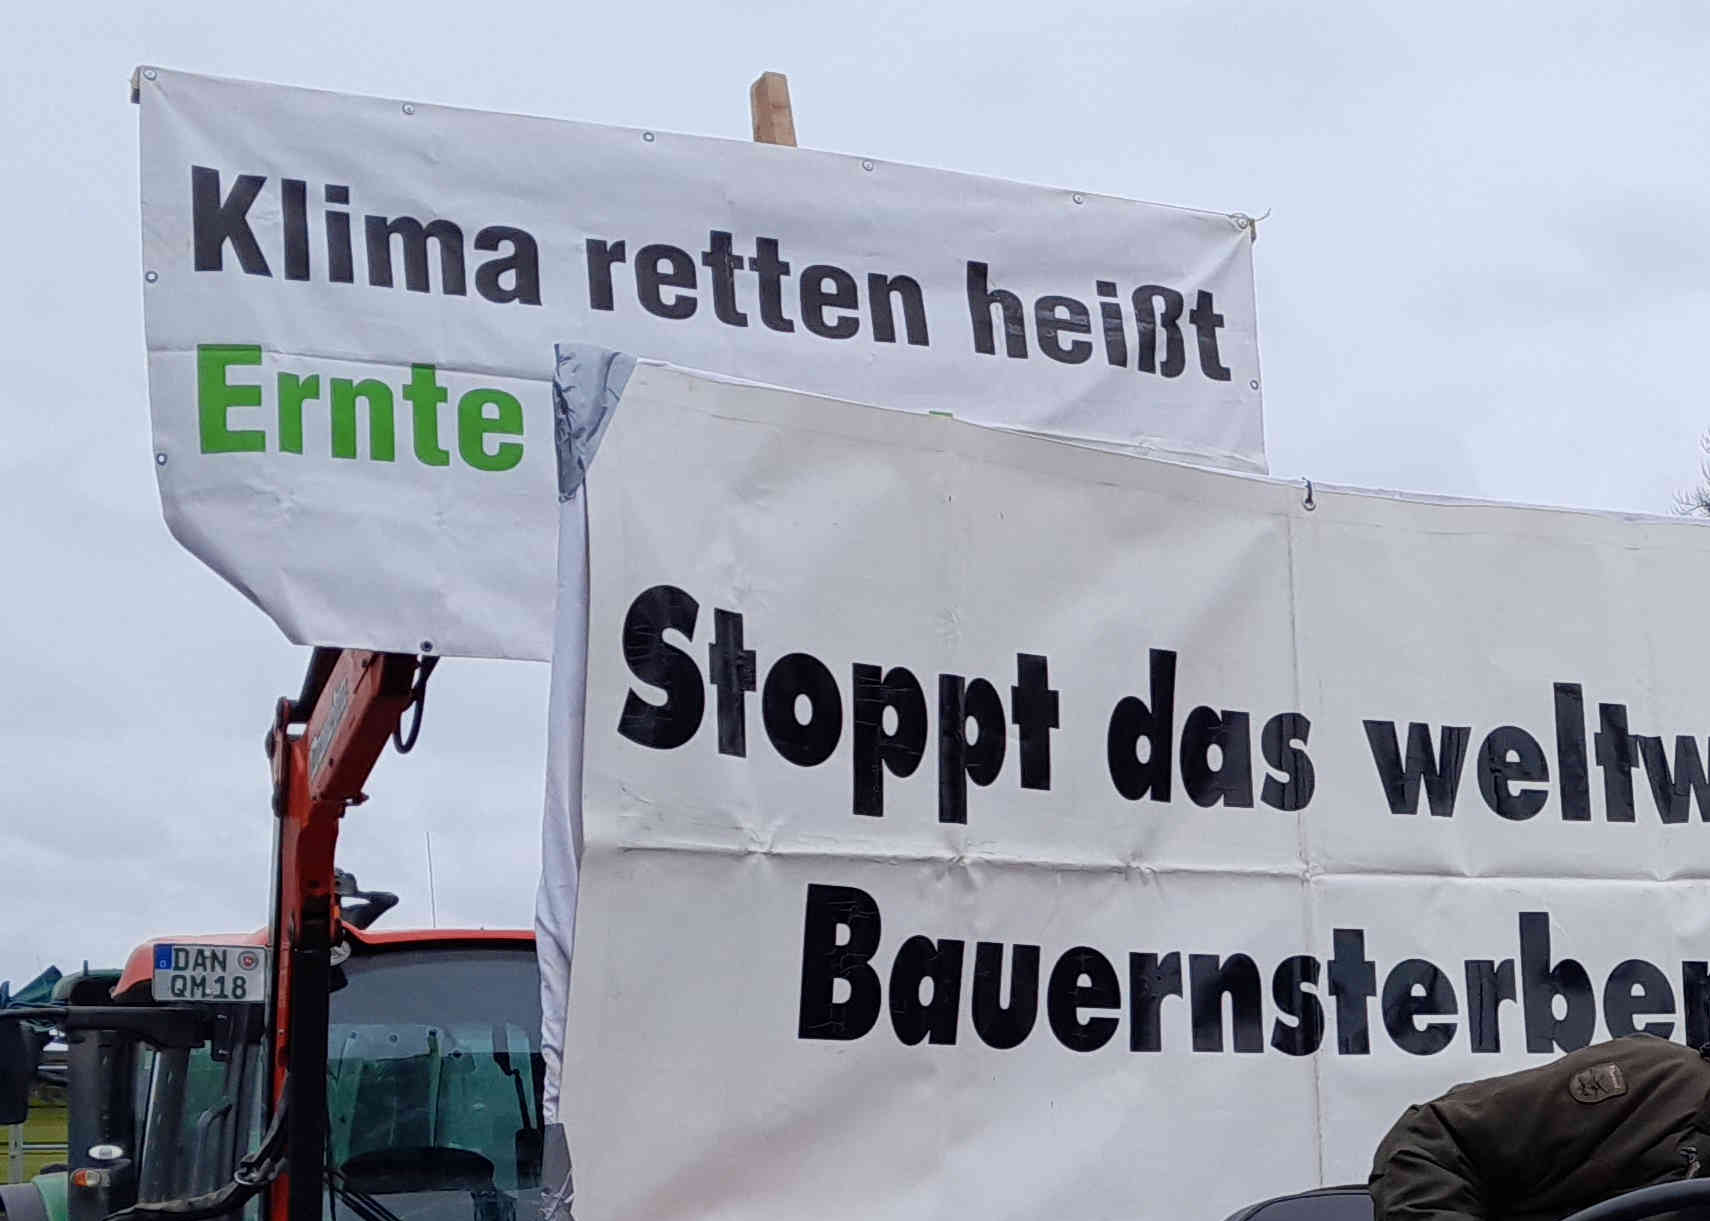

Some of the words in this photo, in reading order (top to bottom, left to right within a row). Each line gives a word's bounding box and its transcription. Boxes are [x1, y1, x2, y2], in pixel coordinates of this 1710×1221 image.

[191, 165, 543, 306] Klima
[584, 230, 930, 346] retten
[966, 260, 1231, 382] heißt
[196, 343, 525, 472] Ernte
[616, 584, 1060, 826] Stoppt
[1107, 648, 1316, 810] das
[170, 973, 207, 999] QM
[214, 975, 247, 1000] 18
[172, 947, 228, 973] DAN
